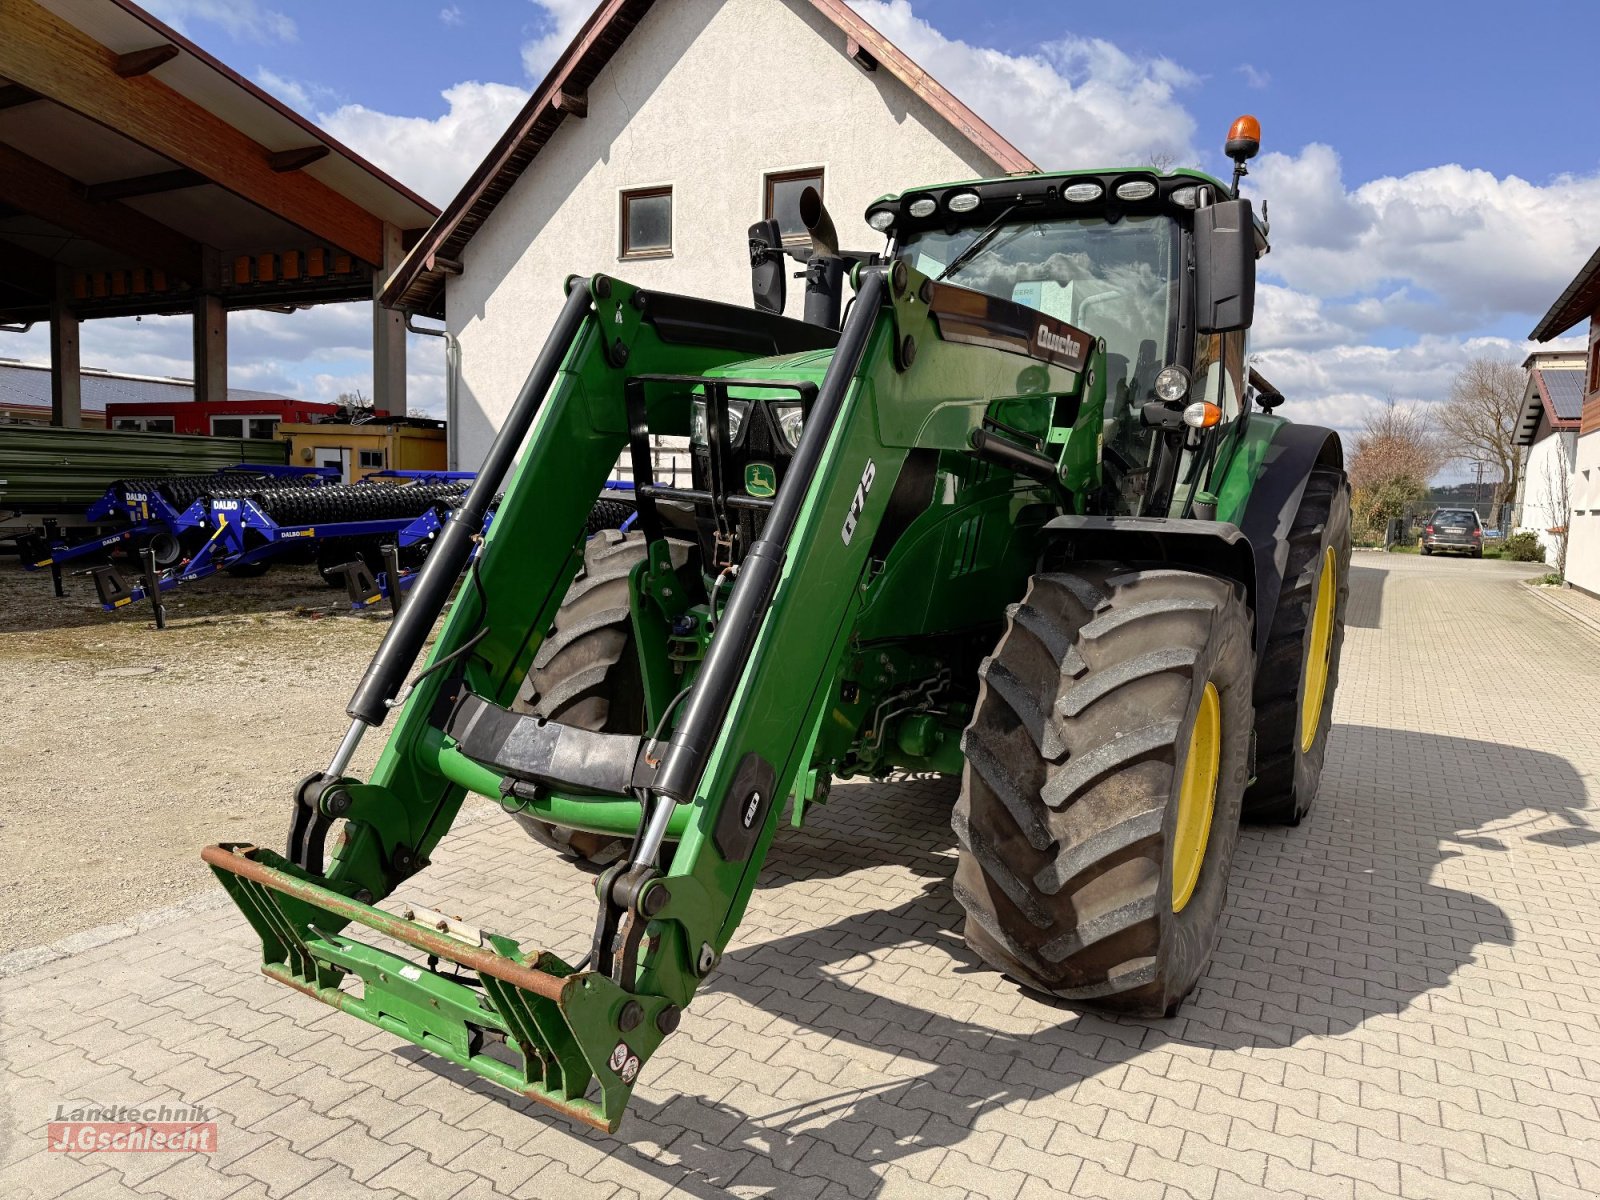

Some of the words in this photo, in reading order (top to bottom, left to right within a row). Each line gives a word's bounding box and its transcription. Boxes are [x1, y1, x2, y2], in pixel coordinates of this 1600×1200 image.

[1037, 324, 1081, 358] Quicke
[125, 492, 148, 502] DALBO
[213, 500, 238, 510] DALBO
[281, 530, 301, 538] DALBO
[102, 536, 121, 546] DALBO
